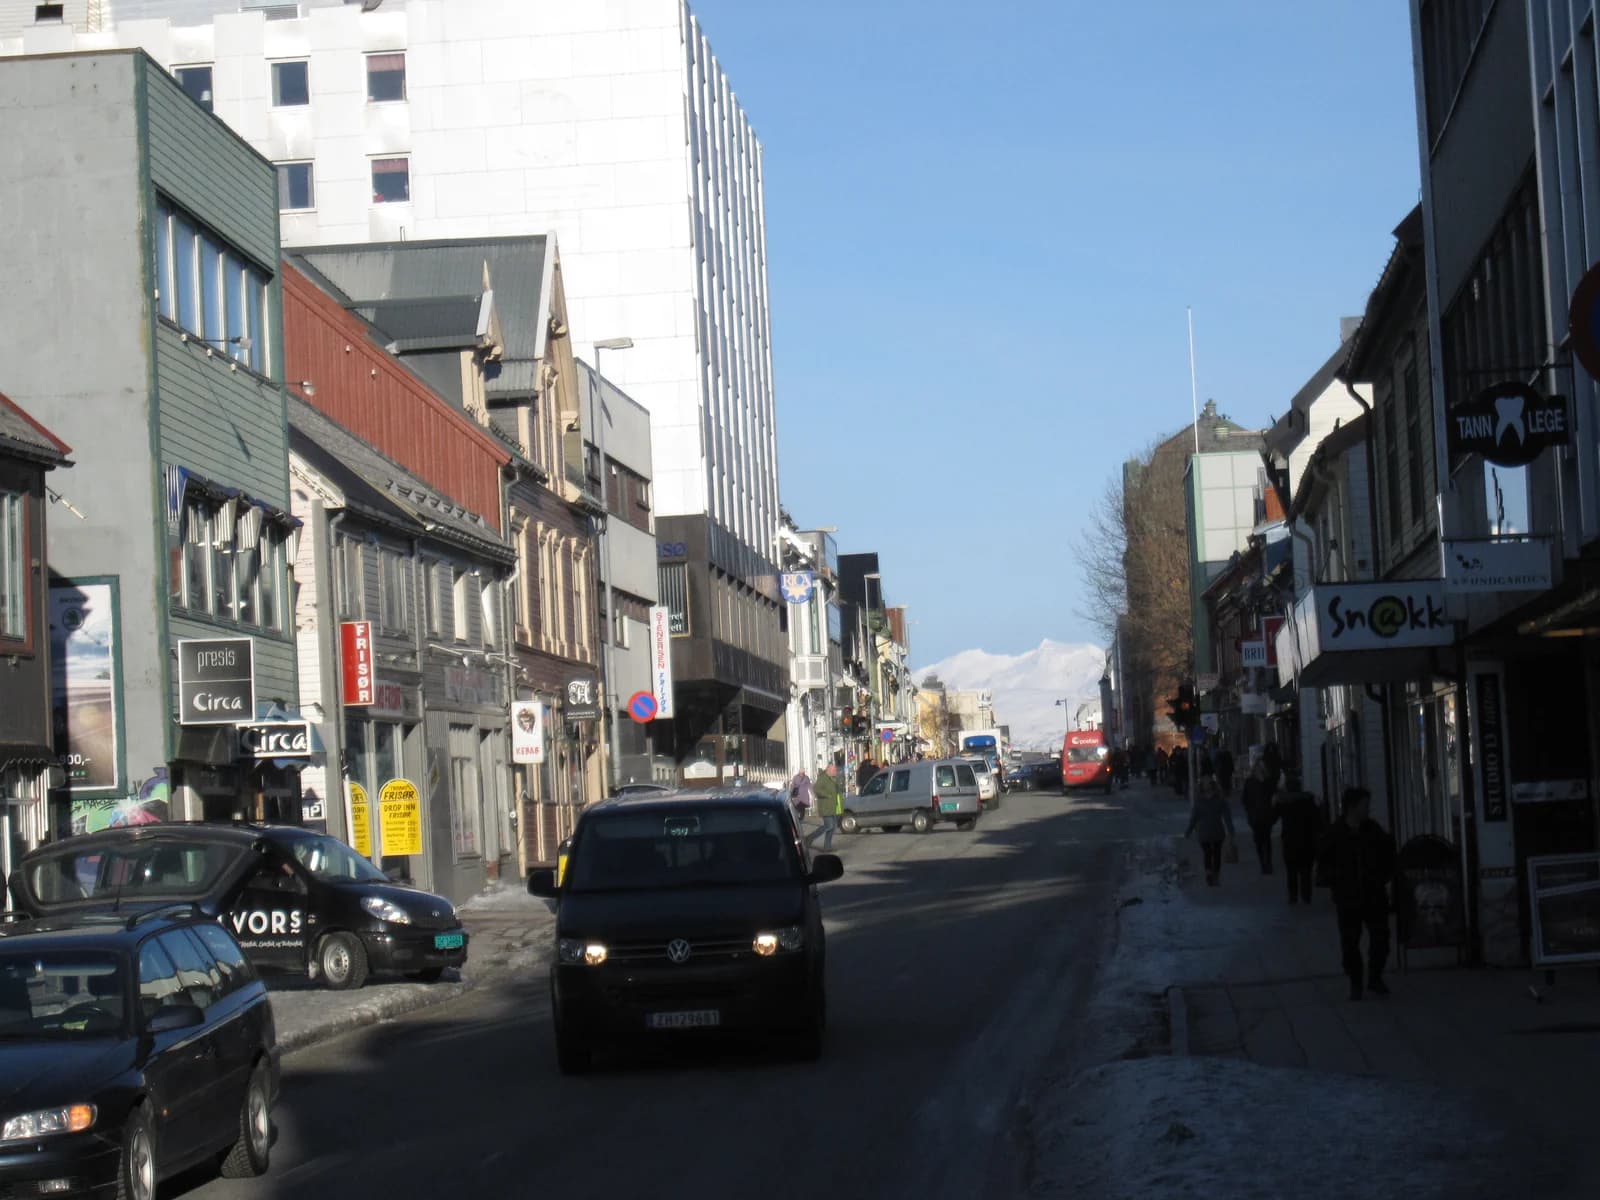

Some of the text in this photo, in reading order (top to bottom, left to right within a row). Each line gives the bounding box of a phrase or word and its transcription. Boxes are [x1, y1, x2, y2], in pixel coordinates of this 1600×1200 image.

[1456, 408, 1564, 440] TANN LEGE
[1328, 594, 1445, 638] Sn@kk
[197, 648, 236, 673] presis
[355, 624, 369, 702] FRISØR
[193, 692, 243, 711] Circa
[242, 727, 307, 753] Circa
[515, 746, 540, 756] KEBAB
[384, 790, 415, 800] FRISØR
